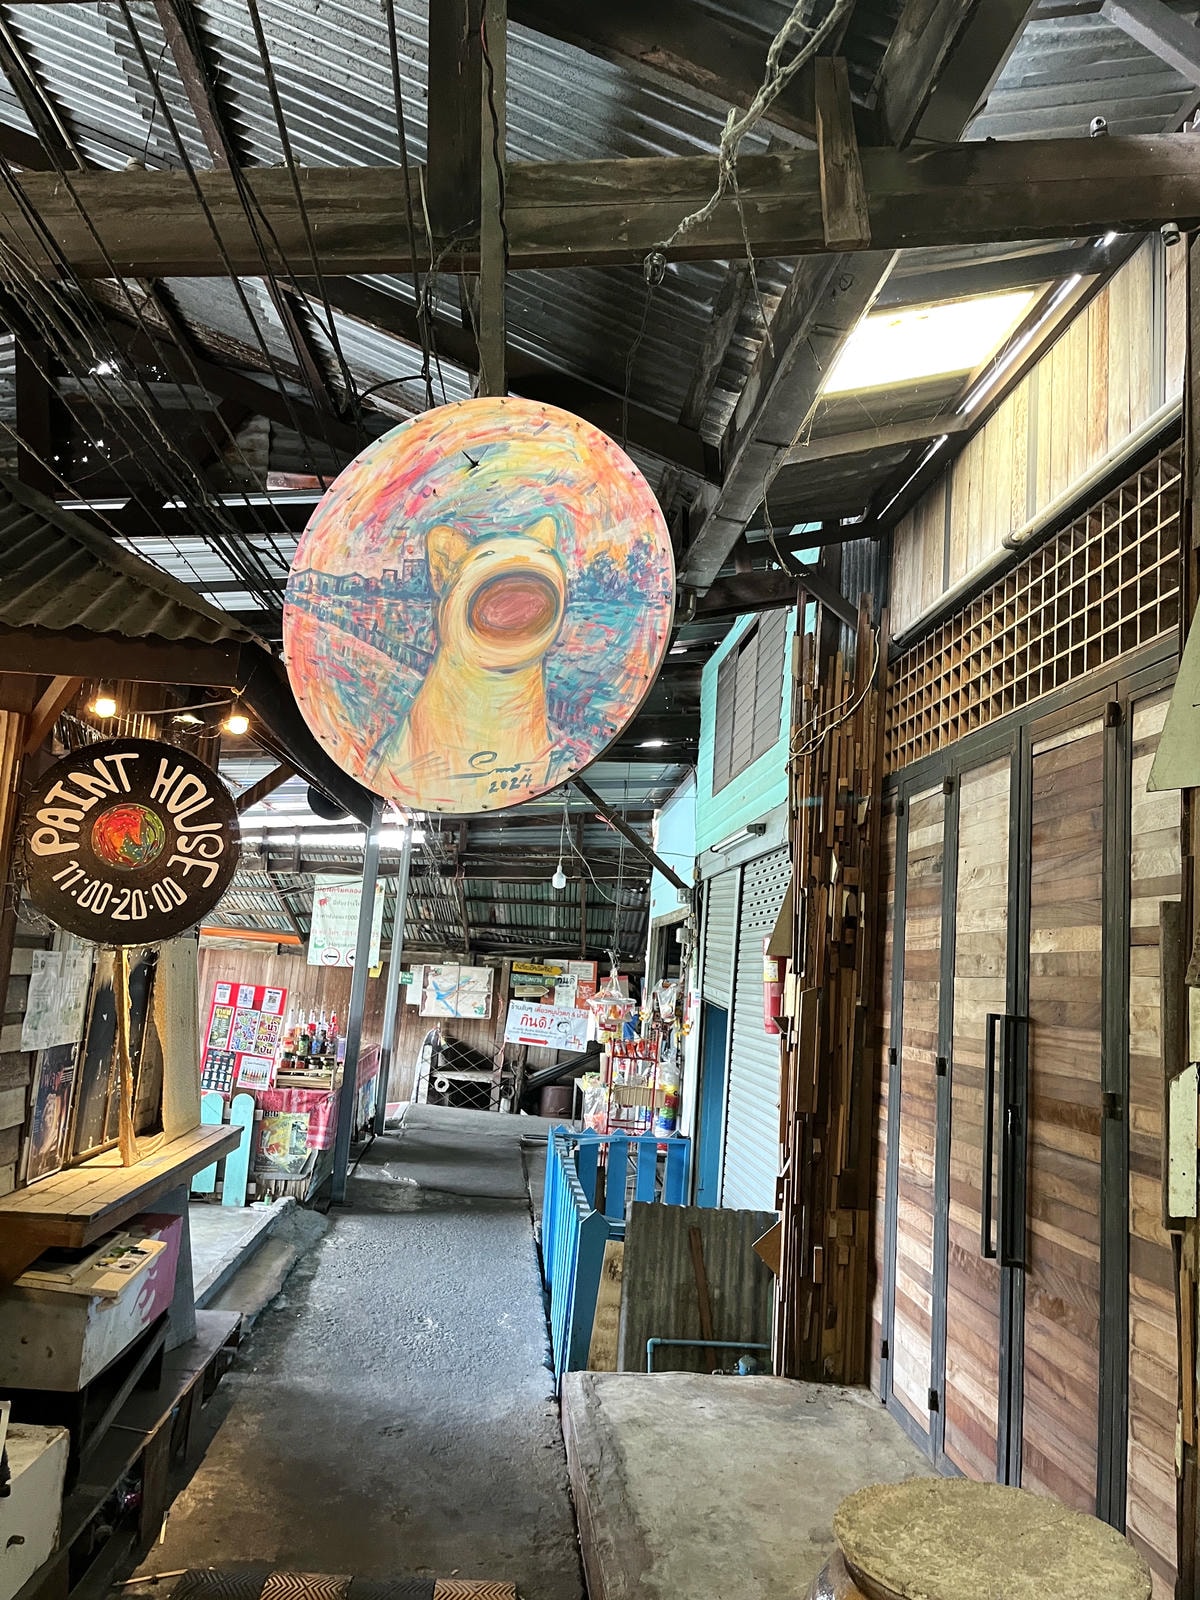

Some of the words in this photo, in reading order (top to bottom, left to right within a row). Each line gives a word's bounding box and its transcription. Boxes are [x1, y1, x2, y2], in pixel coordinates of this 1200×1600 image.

[488, 774, 533, 793] 2024
[31, 753, 139, 857] PAINT
[150, 758, 224, 888] HOUSE
[52, 860, 188, 921] 11:00-20:00
